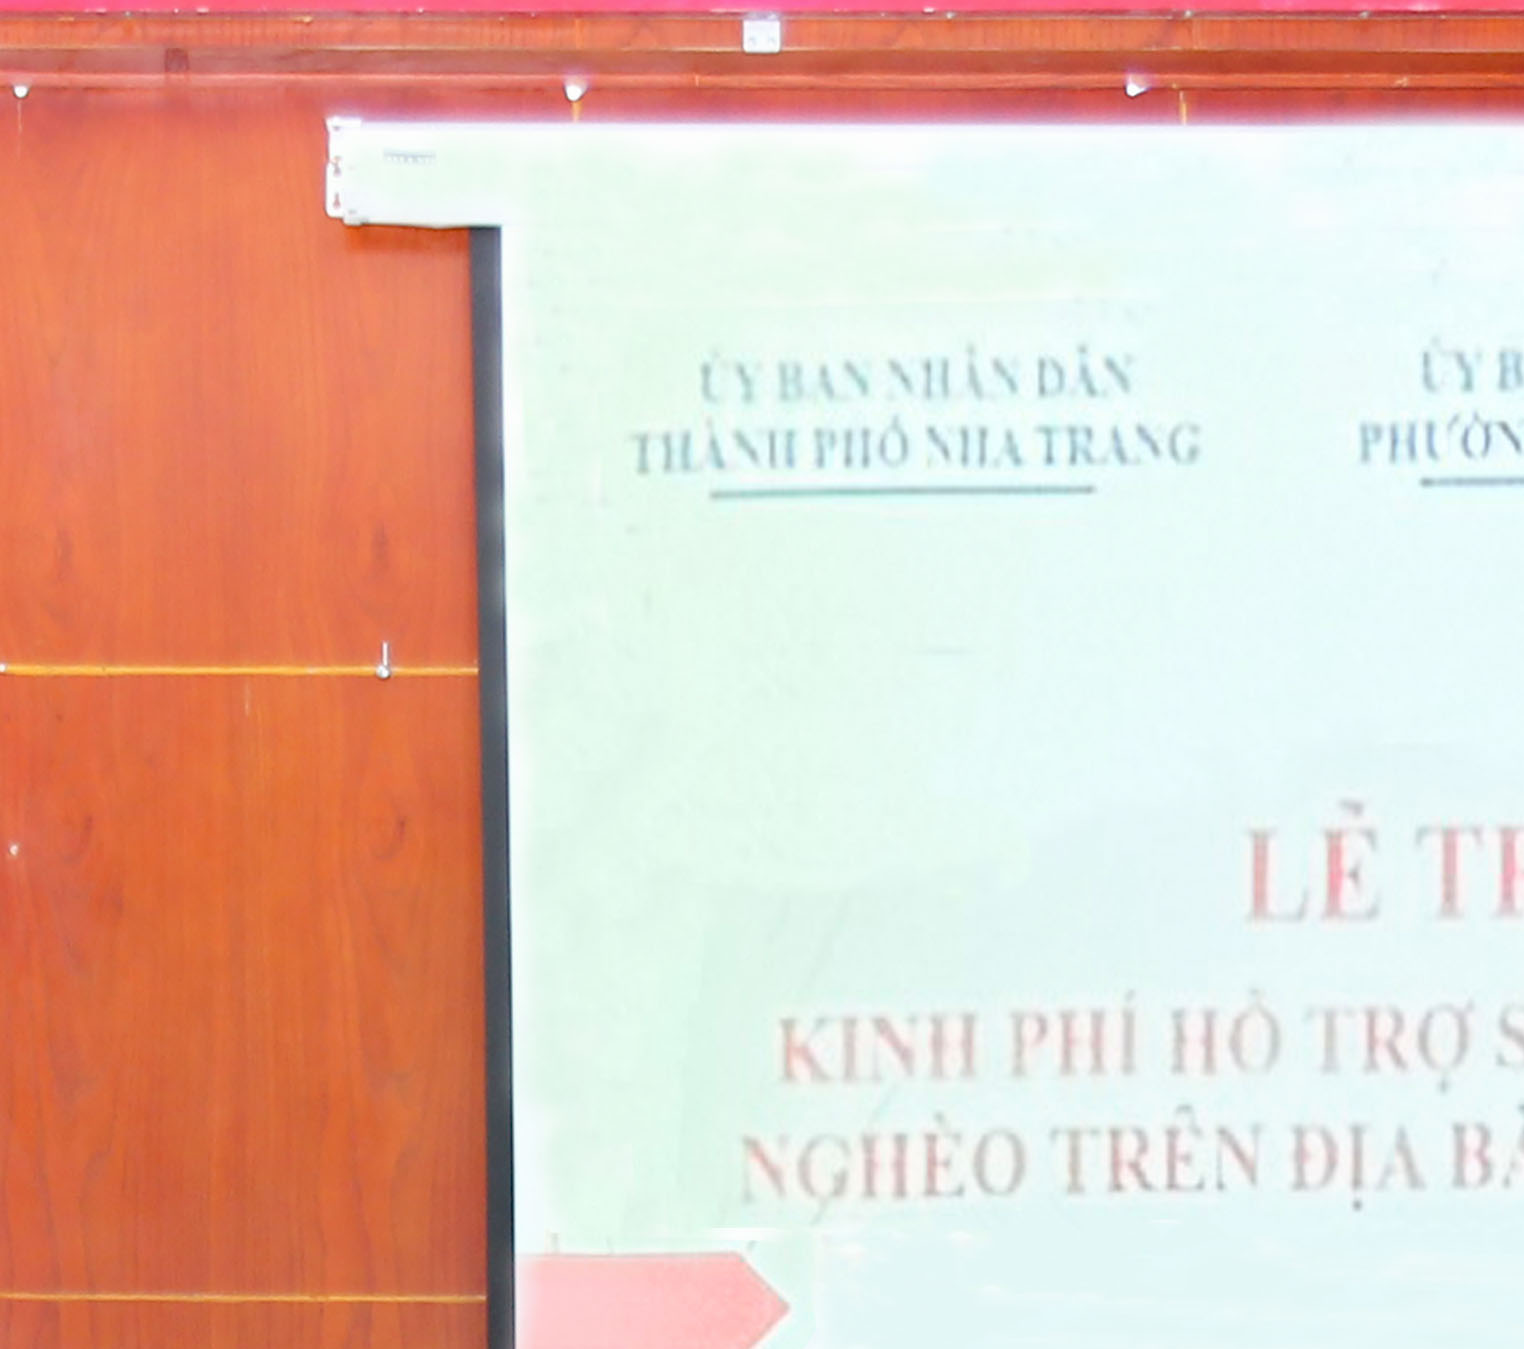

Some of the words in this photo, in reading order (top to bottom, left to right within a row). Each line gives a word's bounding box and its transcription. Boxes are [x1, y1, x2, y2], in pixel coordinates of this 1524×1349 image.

[778, 361, 871, 402] BAN
[888, 344, 1020, 400] NHÂN
[1037, 343, 1134, 398] DÂN
[630, 417, 797, 475] THÀNH
[814, 414, 910, 469] PHỐ
[926, 426, 1024, 468] NHA
[1034, 421, 1202, 466] TRANG
[779, 1014, 979, 1085] KINH
[1008, 989, 1140, 1078] PHÍ
[1169, 987, 1282, 1078] HỖ
[1307, 1000, 1477, 1094] TRỢ
[739, 1110, 1027, 1206] NGHÈO
[1050, 1102, 1263, 1196] TRÊN
[1288, 1124, 1427, 1211] ĐỊA
